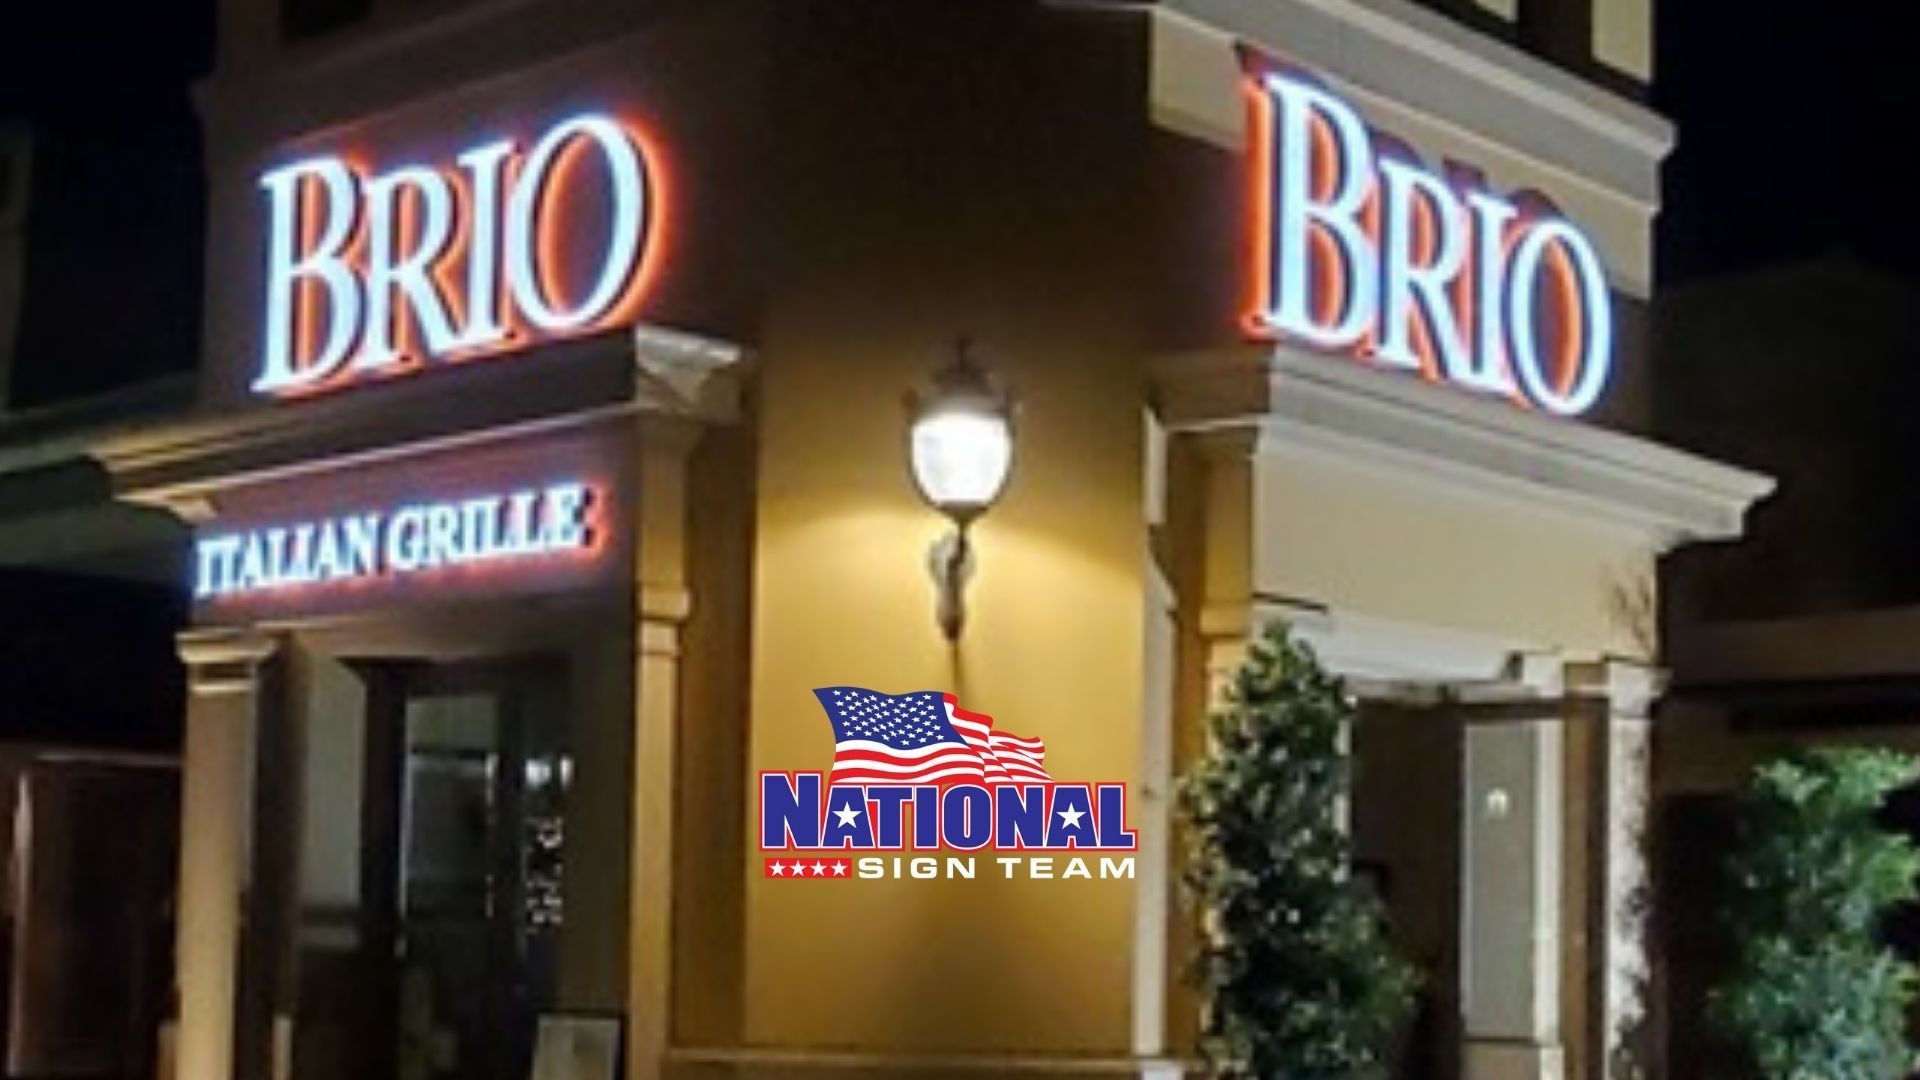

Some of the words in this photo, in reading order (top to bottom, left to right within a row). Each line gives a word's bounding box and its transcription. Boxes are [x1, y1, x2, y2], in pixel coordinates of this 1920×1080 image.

[250, 114, 644, 393] BRIO
[1262, 72, 1612, 416] BRIO
[194, 513, 380, 598] ITALIAN
[386, 483, 585, 570] GRILLE
